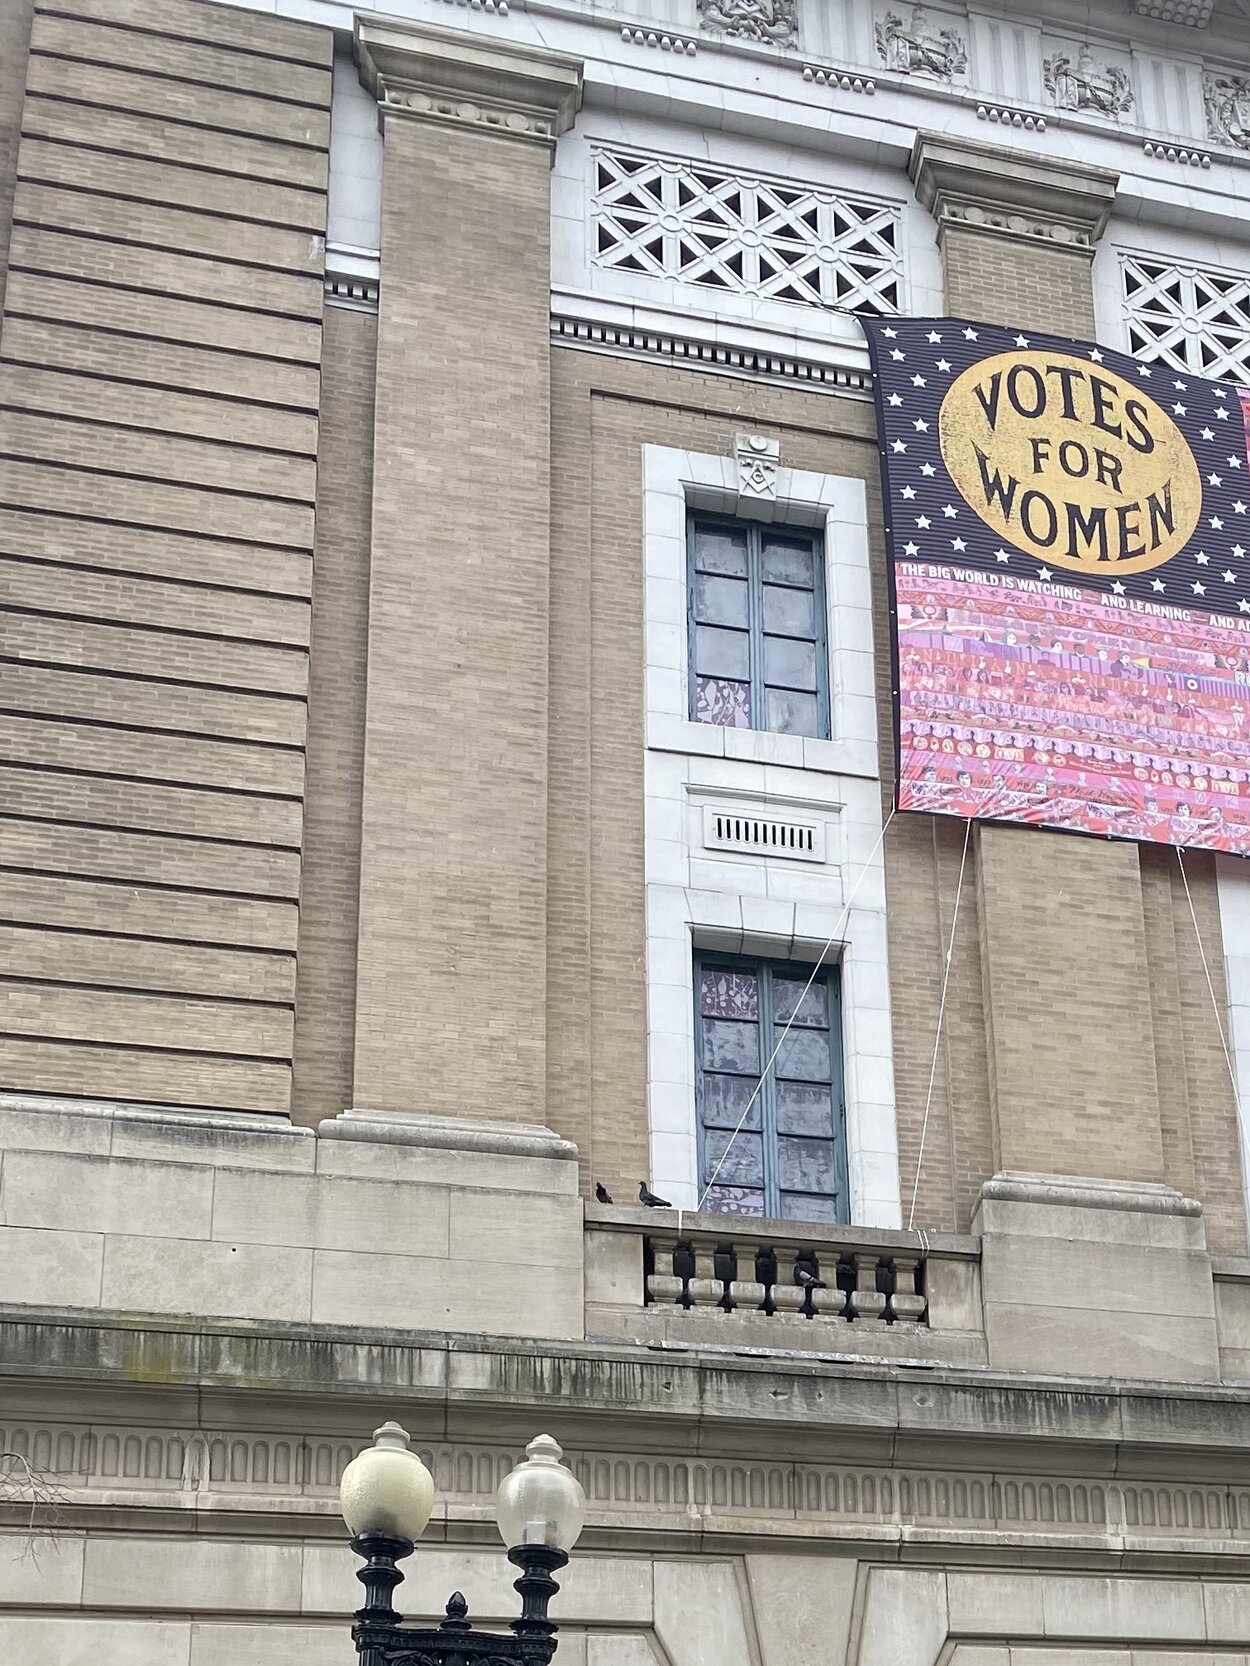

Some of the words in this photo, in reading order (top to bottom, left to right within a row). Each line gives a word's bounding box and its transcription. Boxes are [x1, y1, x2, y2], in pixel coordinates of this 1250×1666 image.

[972, 363, 1155, 454] VOTES
[971, 439, 1176, 562] WOMEN
[1028, 437, 1123, 494] FOR
[900, 563, 926, 577] THE
[929, 566, 951, 580] BIG
[953, 569, 999, 586] WORLD
[1002, 575, 1015, 589] IS
[1016, 577, 1082, 601] WATCHING
[1100, 593, 1127, 609] AND
[1129, 597, 1191, 622] LEARNING
[1209, 614, 1235, 630] AND
